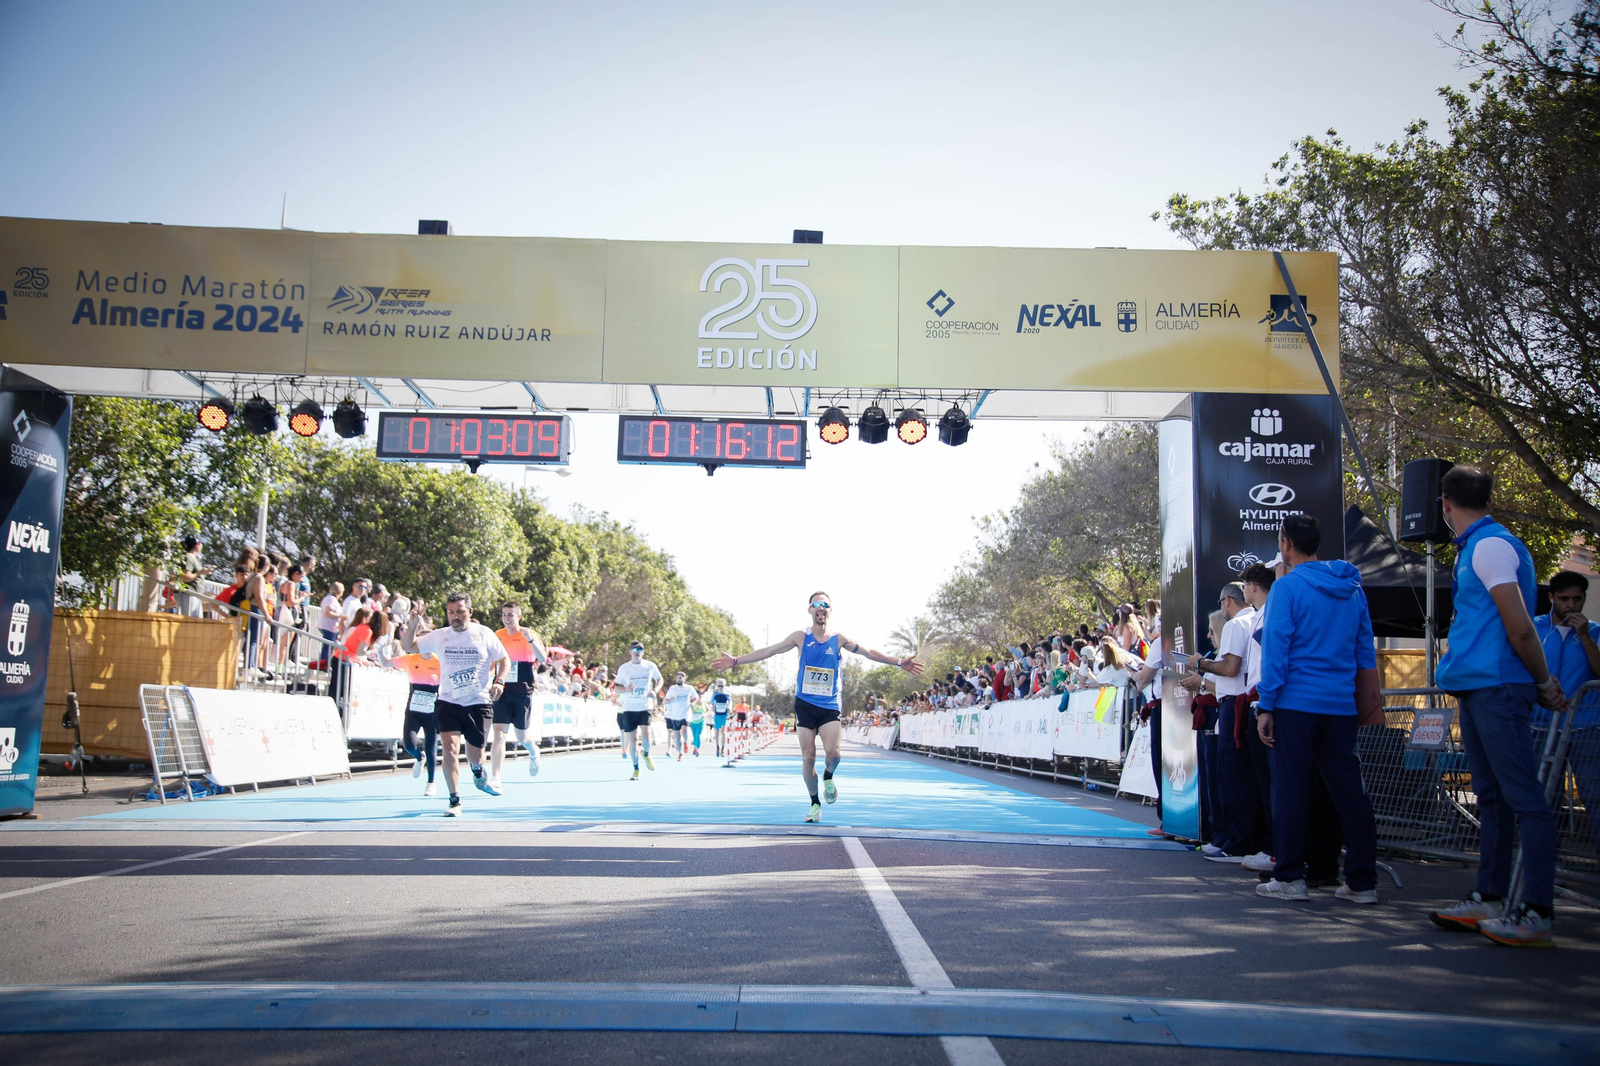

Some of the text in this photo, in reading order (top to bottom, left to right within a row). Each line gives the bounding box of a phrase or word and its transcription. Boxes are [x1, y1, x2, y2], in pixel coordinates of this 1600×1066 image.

[14, 266, 50, 291] 25
[76, 269, 306, 301] Medio Maratón
[384, 288, 431, 300] RFEA
[698, 257, 818, 341] 25
[379, 299, 425, 309] SERIES
[407, 308, 452, 317] RUNNING
[1155, 299, 1241, 319] ALMERÍA
[71, 297, 304, 333] Almería 2024
[323, 320, 552, 342] RAMÓN RUIZ ANDÚJAR
[925, 320, 999, 332] COOPERACIÓN
[925, 329, 951, 339] 2005
[1155, 320, 1199, 331] CIUDAD
[697, 343, 818, 371] EDICIÓN
[647, 420, 799, 462] 01:16:12
[1218, 436, 1316, 462] cajamar
[10, 454, 28, 469] 2005
[11, 443, 58, 468] COOPERACIÓN
[1265, 457, 1314, 466] CAJA RURAL
[811, 671, 829, 682] 773
[1414, 730, 1443, 741] EVENTOS
